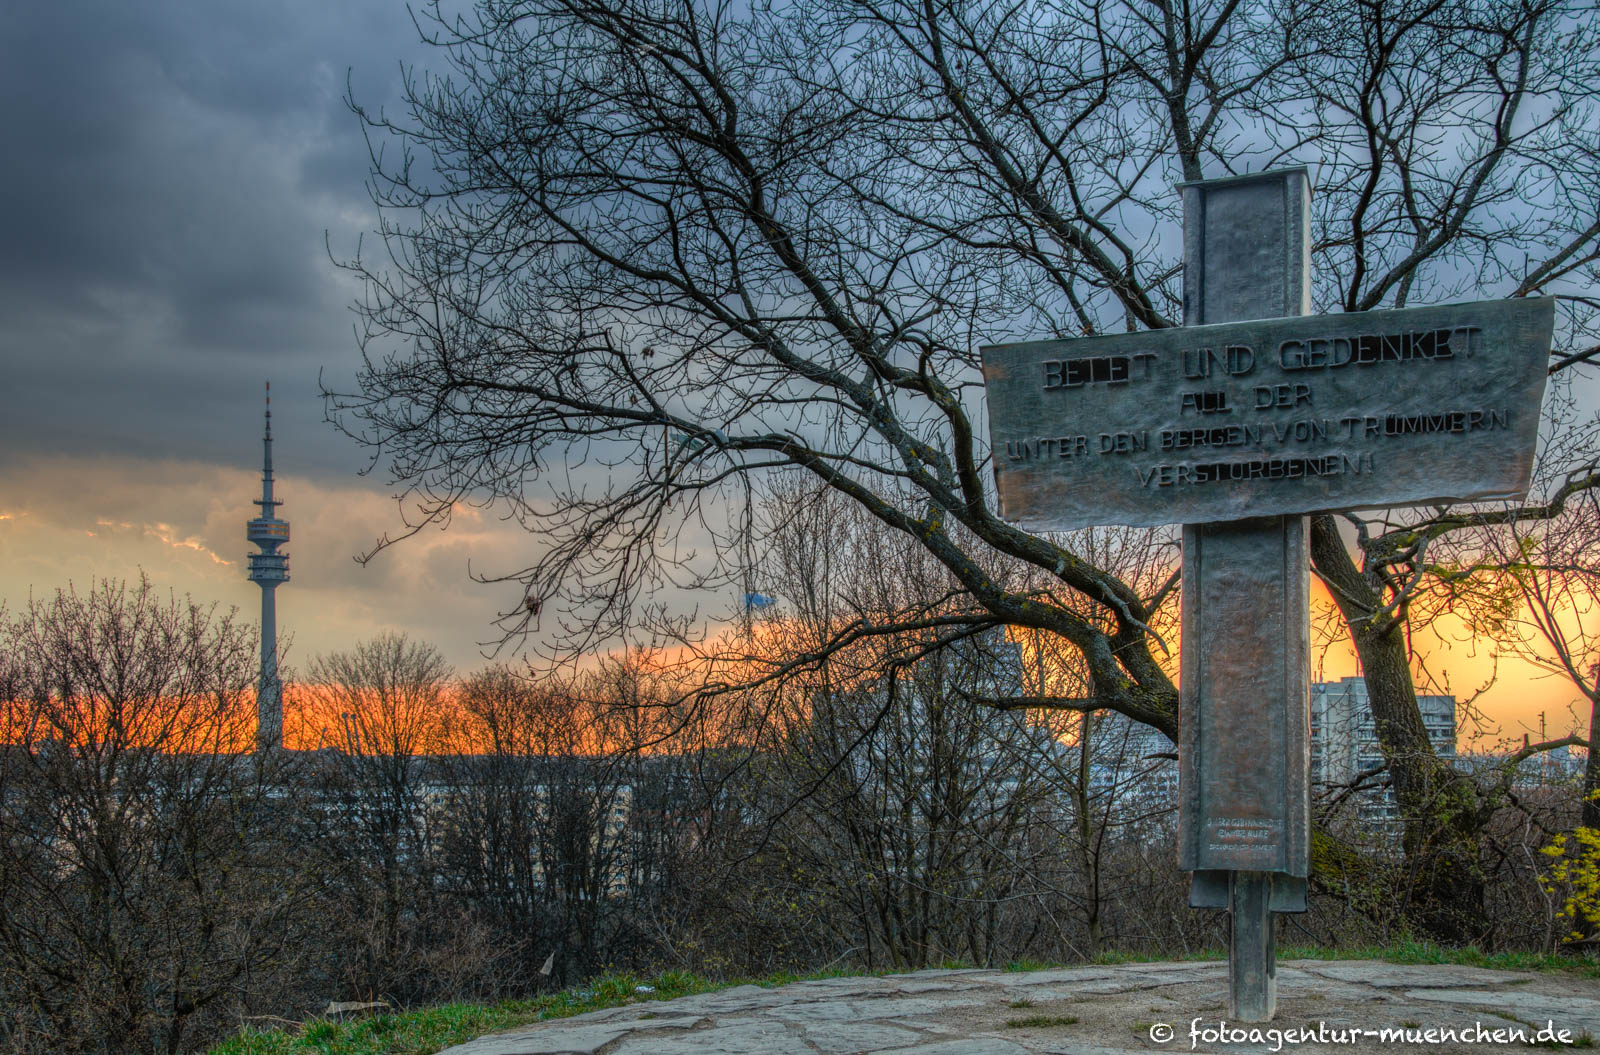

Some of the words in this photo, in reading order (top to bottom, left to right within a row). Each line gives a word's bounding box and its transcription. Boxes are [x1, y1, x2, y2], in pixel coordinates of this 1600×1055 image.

[1042, 353, 1159, 390] BETET
[1180, 345, 1255, 379] UND
[1278, 325, 1482, 371] GEDENKET
[1180, 390, 1233, 416] ALL
[1253, 383, 1312, 411] DER
[1005, 434, 1089, 461] UNTER
[1098, 430, 1148, 456] DEN
[1160, 422, 1261, 449] BERGEN
[1271, 418, 1329, 443] VON
